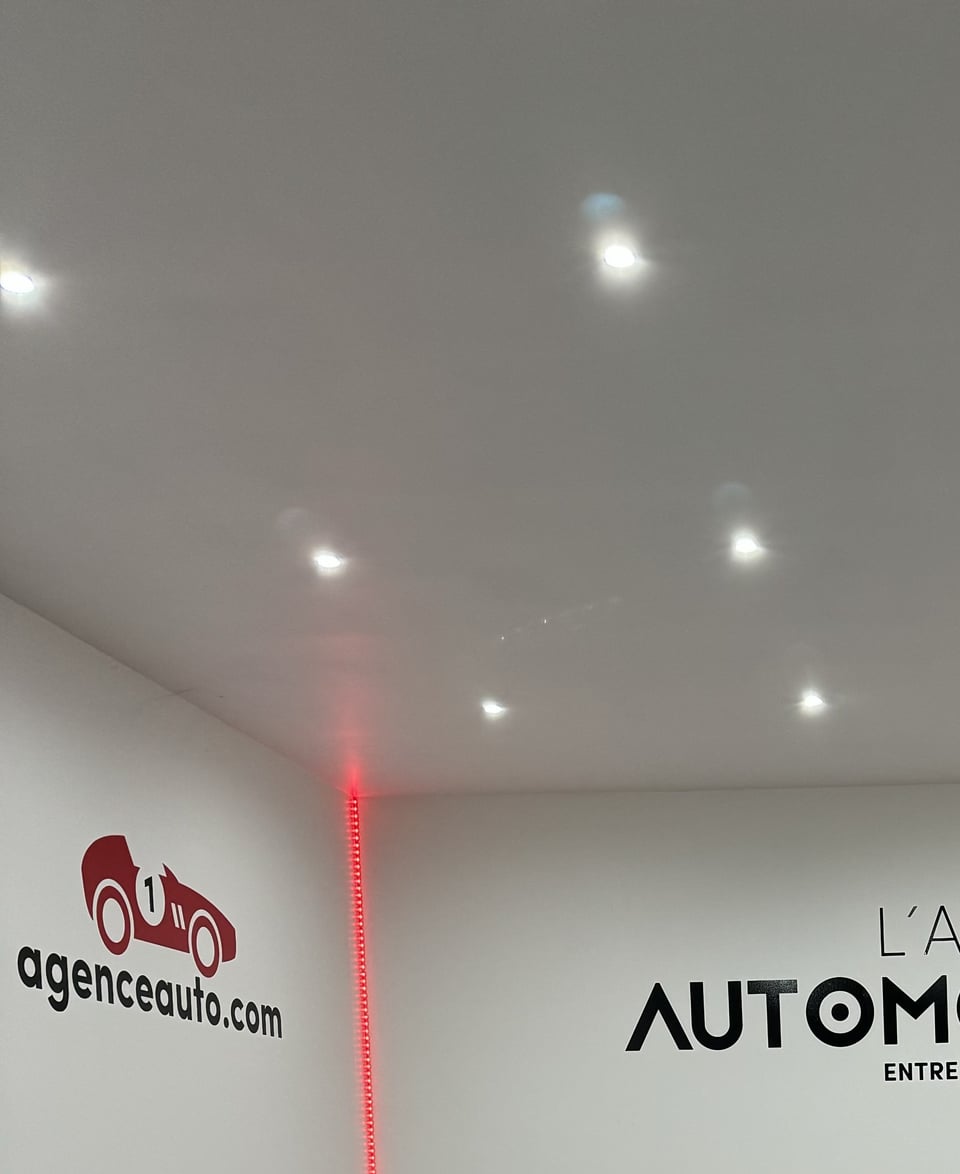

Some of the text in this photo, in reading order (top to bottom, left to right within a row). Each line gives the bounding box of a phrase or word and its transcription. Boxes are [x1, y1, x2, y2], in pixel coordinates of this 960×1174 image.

[143, 876, 155, 913] 1
[17, 946, 283, 1039] agenceauto.com
[884, 1062, 958, 1081] ENTRE
